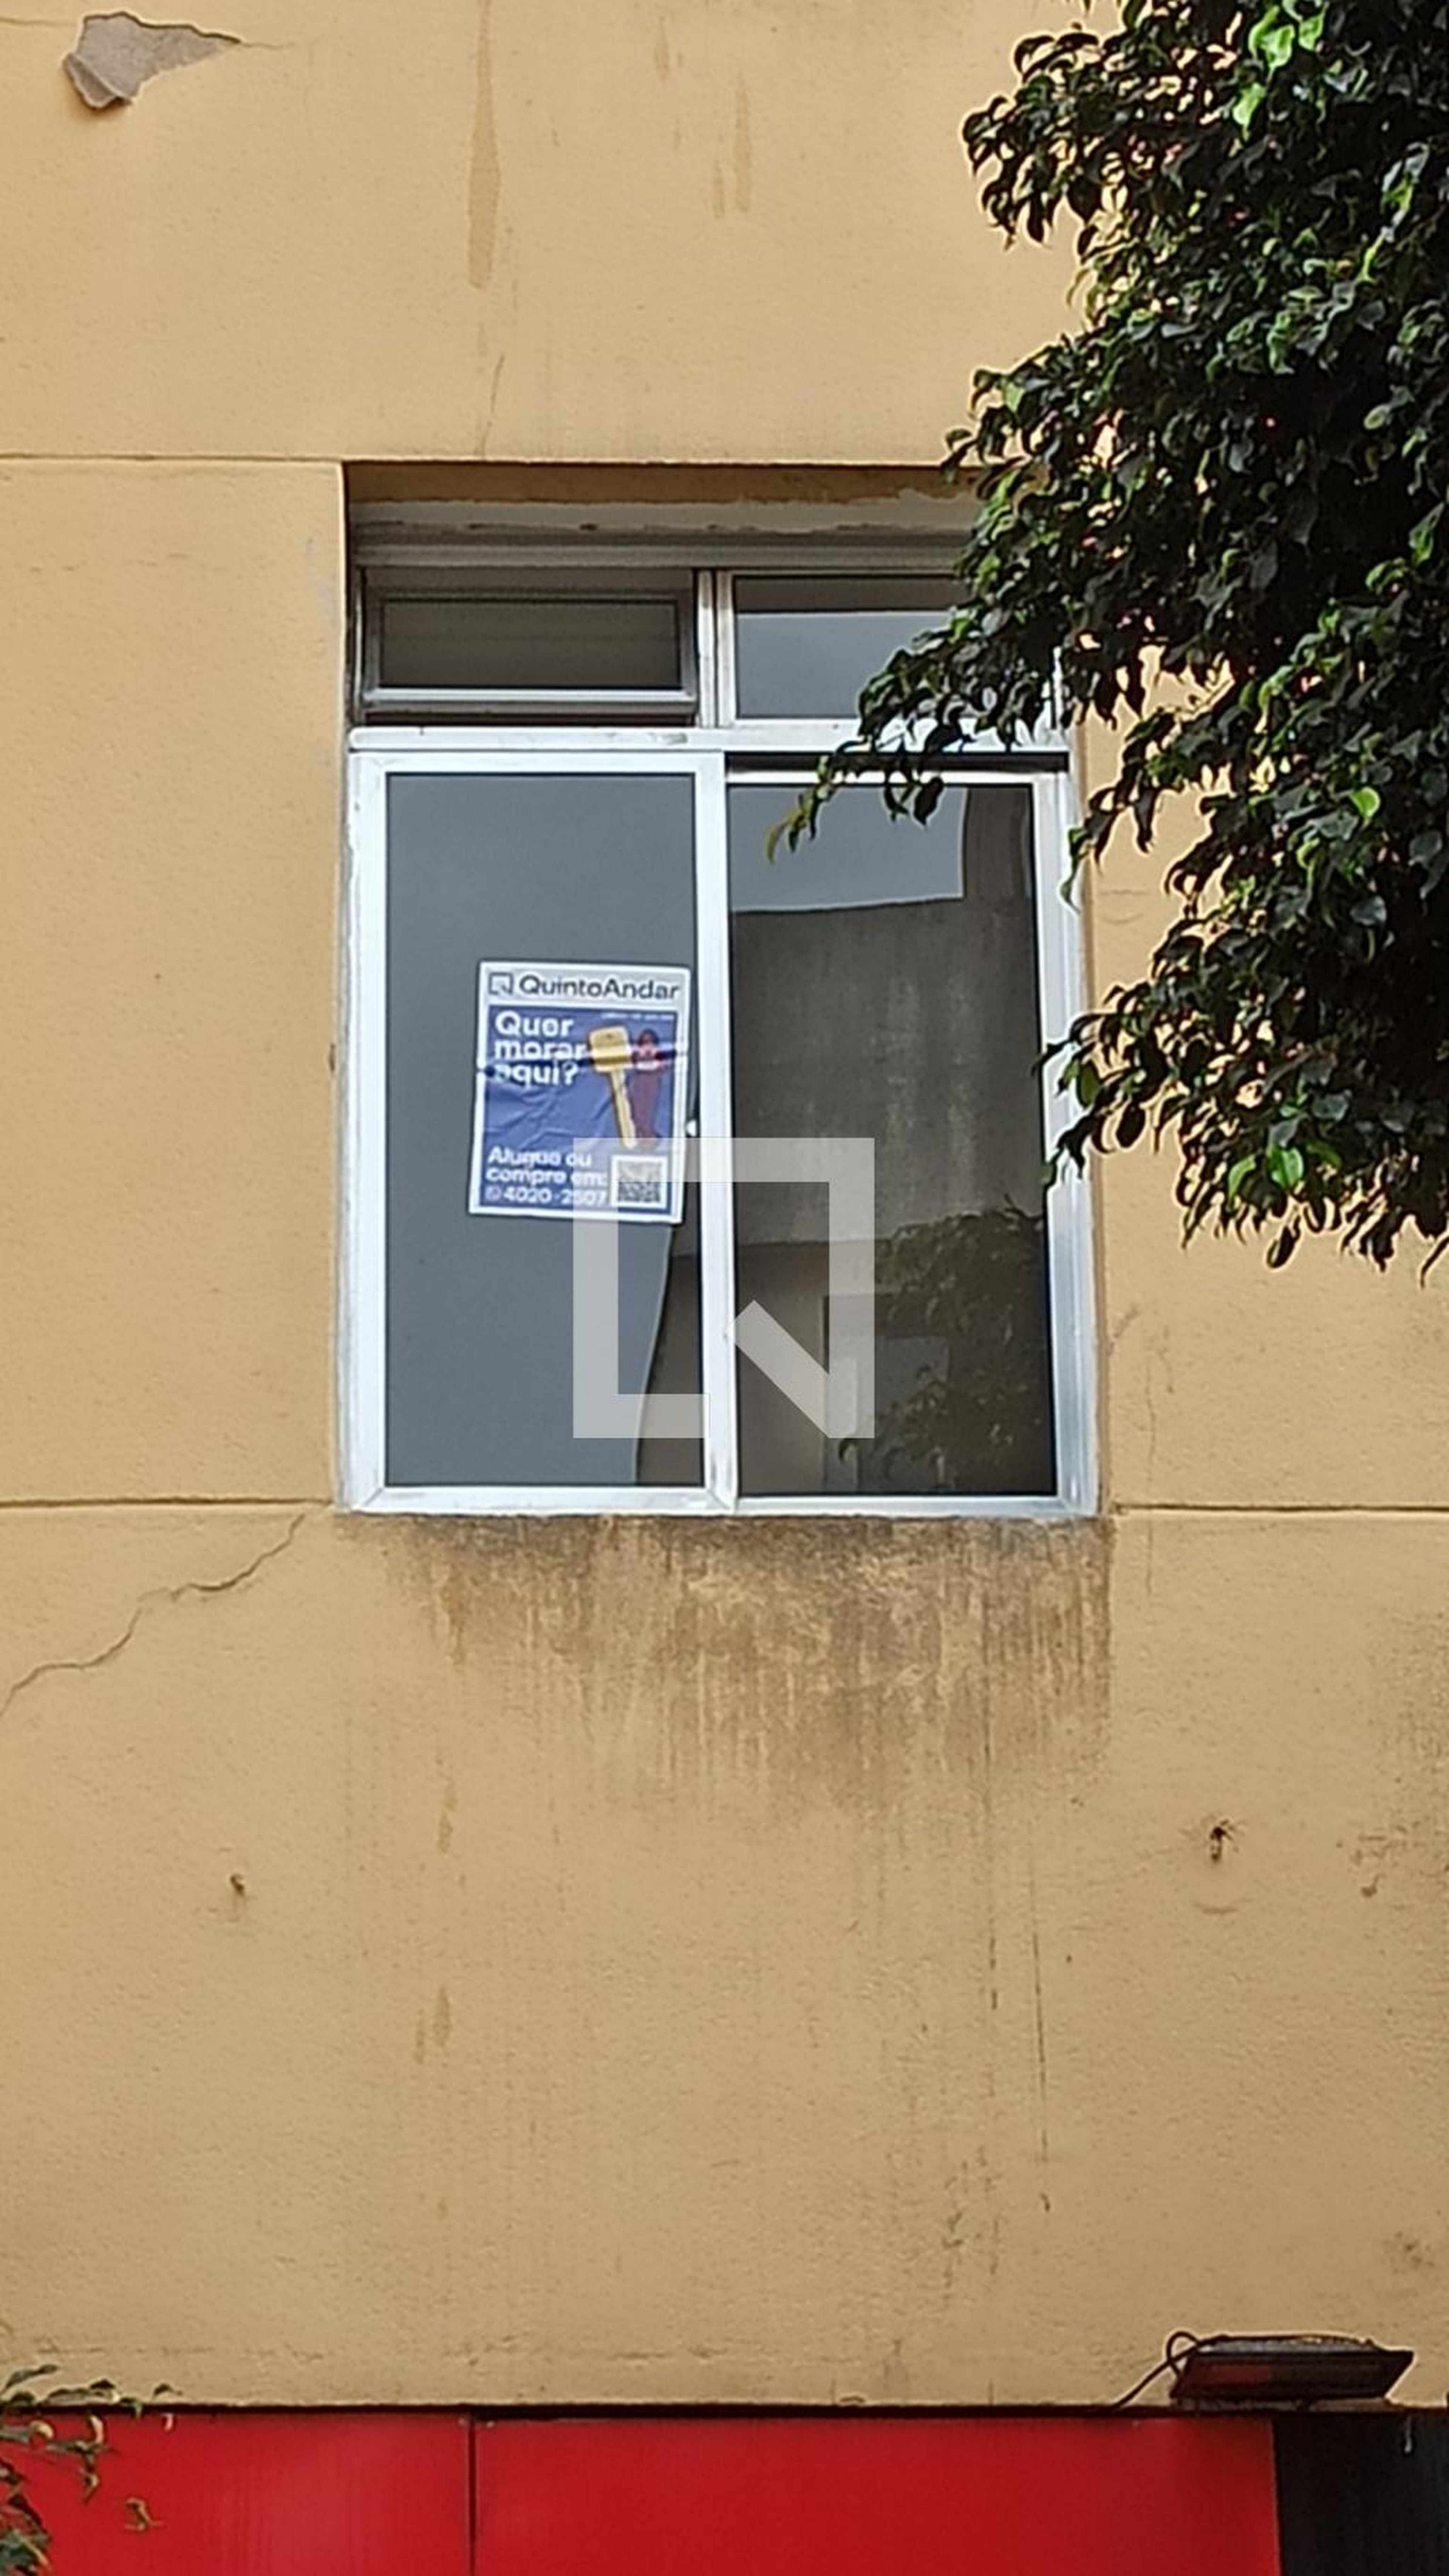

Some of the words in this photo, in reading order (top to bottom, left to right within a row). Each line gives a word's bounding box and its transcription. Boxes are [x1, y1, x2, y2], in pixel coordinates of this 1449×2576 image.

[519, 975, 680, 999] QuintoAndar
[495, 1010, 574, 1037] Quer
[494, 1040, 587, 1061] morar
[488, 1146, 561, 1169] Alugue
[566, 1153, 592, 1167] ou
[485, 1167, 566, 1186] compre
[571, 1172, 608, 1186] em:
